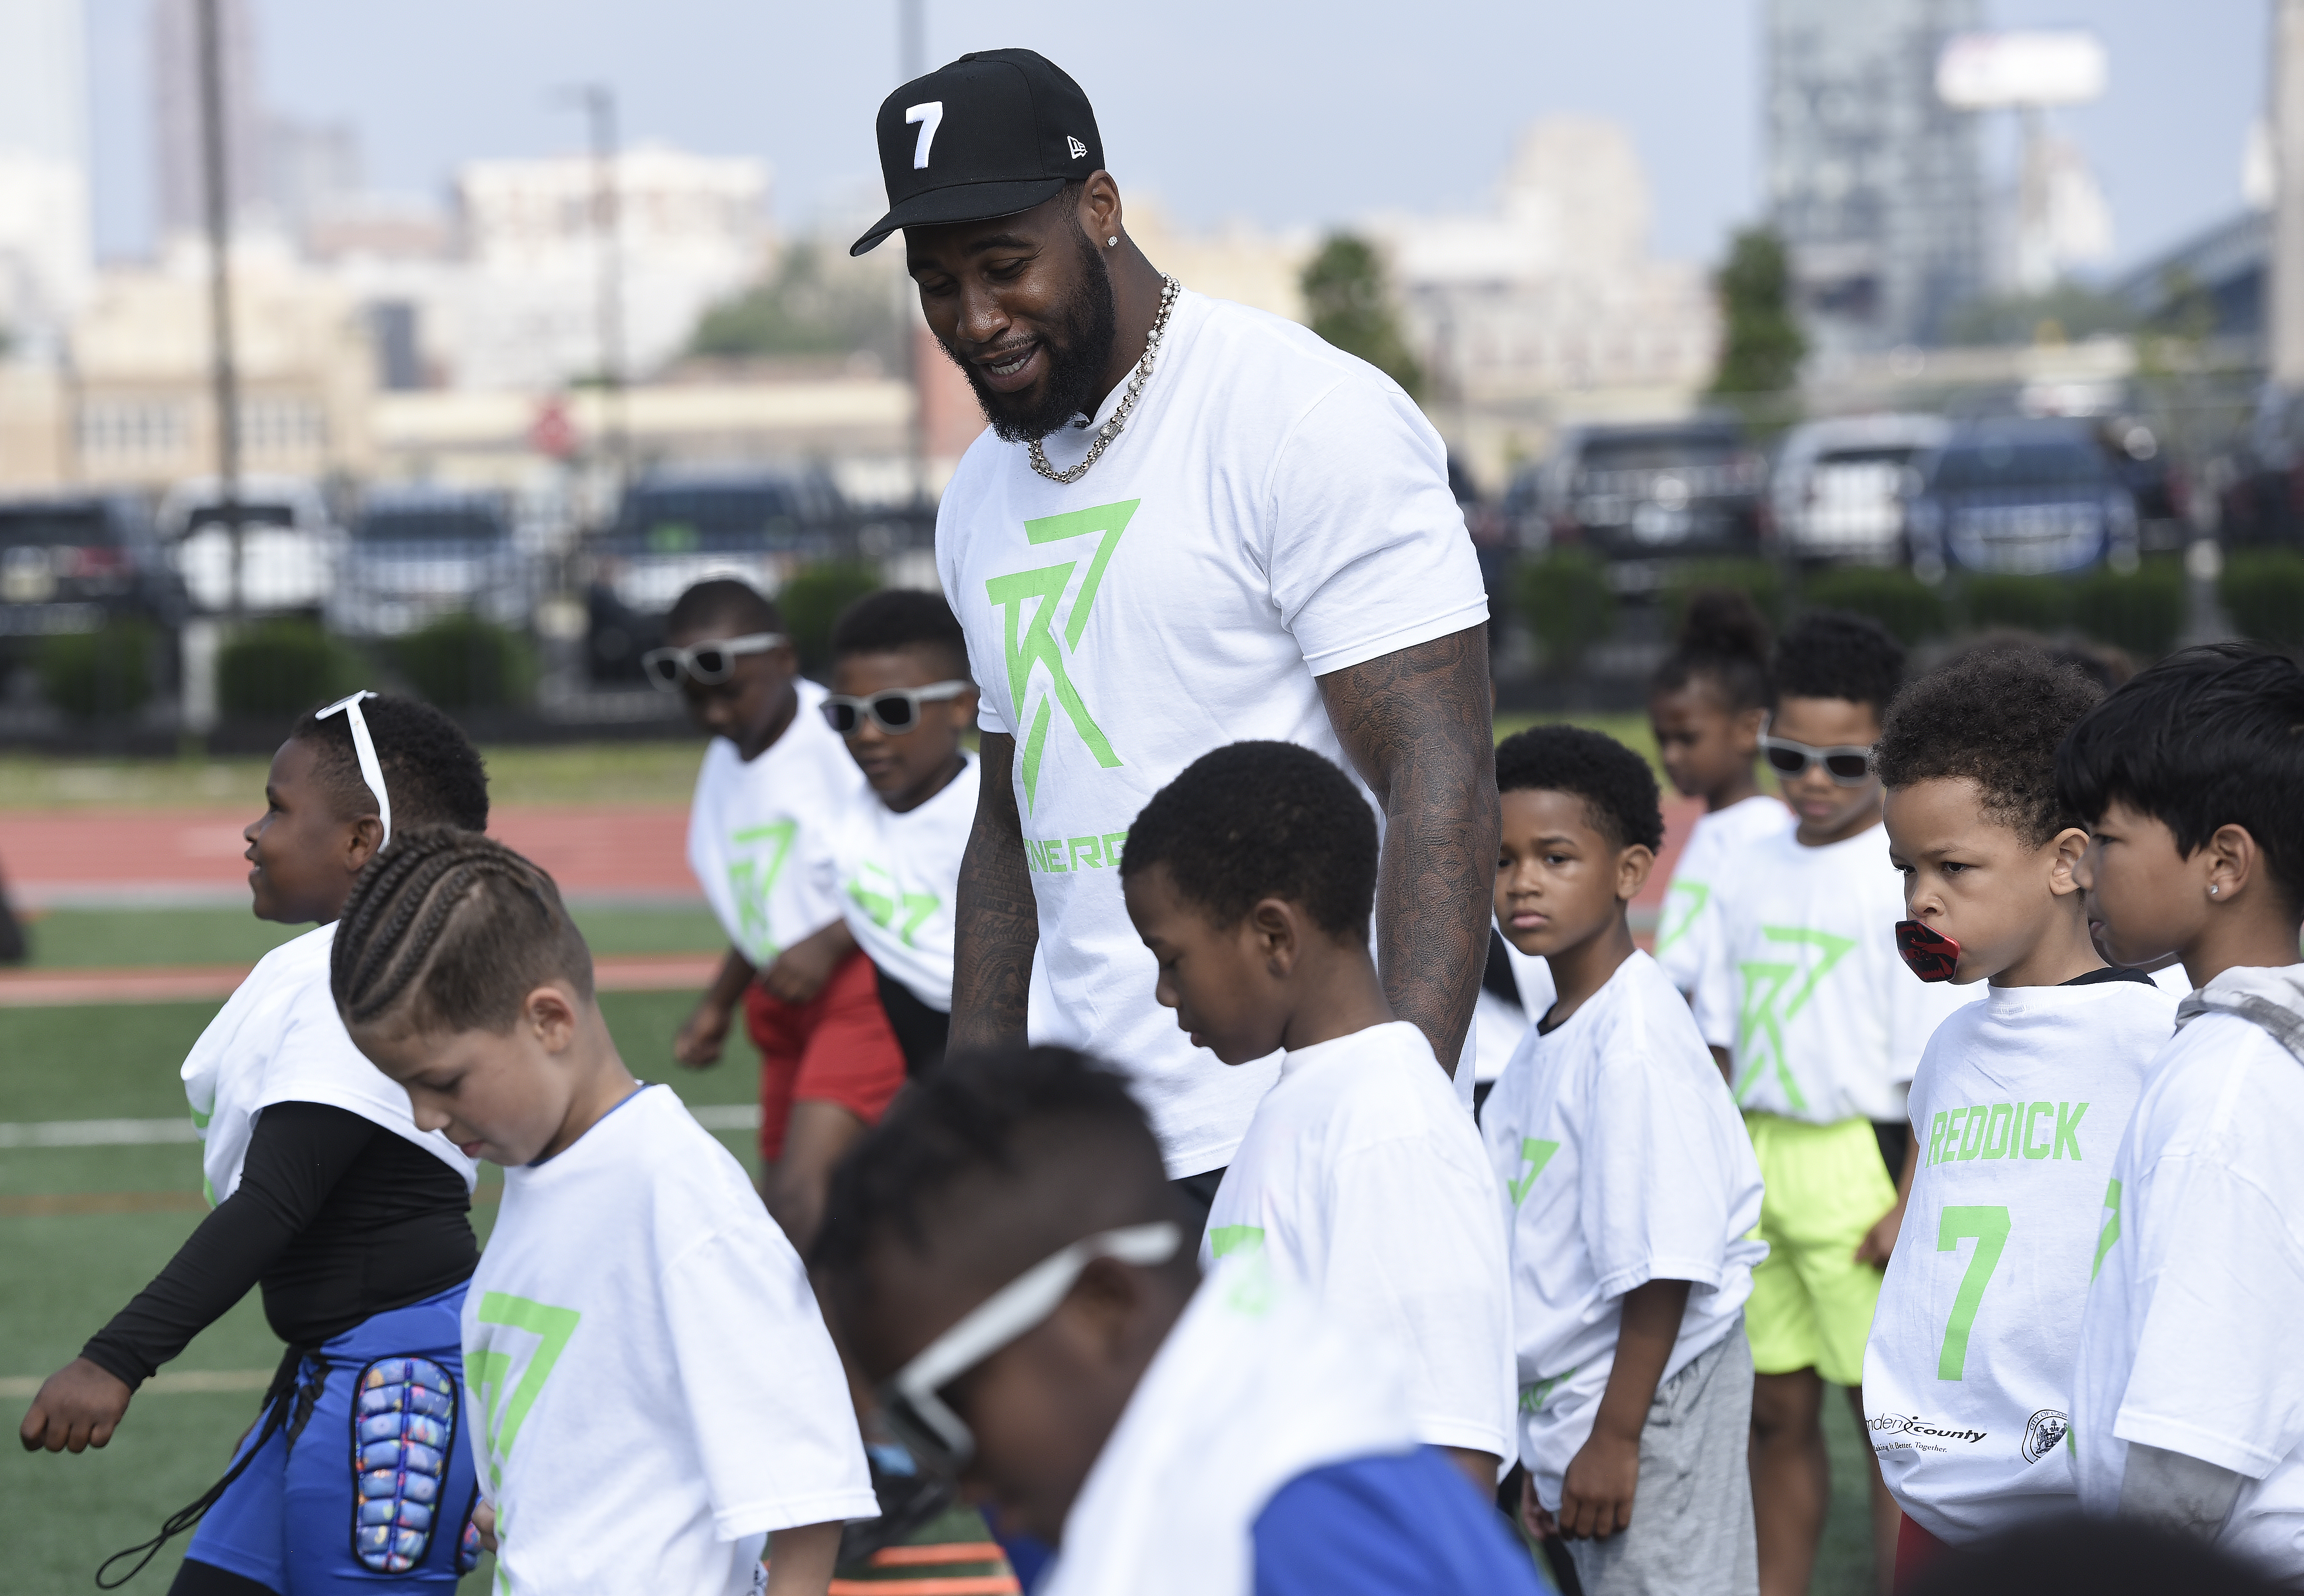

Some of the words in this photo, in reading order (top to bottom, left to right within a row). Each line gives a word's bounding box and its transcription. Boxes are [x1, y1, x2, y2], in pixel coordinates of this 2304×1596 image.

[906, 101, 943, 170] 7
[1925, 1101, 2090, 1168] REDDICK
[1936, 1206, 2012, 1381] 7
[1913, 1426, 1987, 1443] county
[2030, 1414, 2040, 1431] CITY
[1915, 1441, 1947, 1452] Together.
